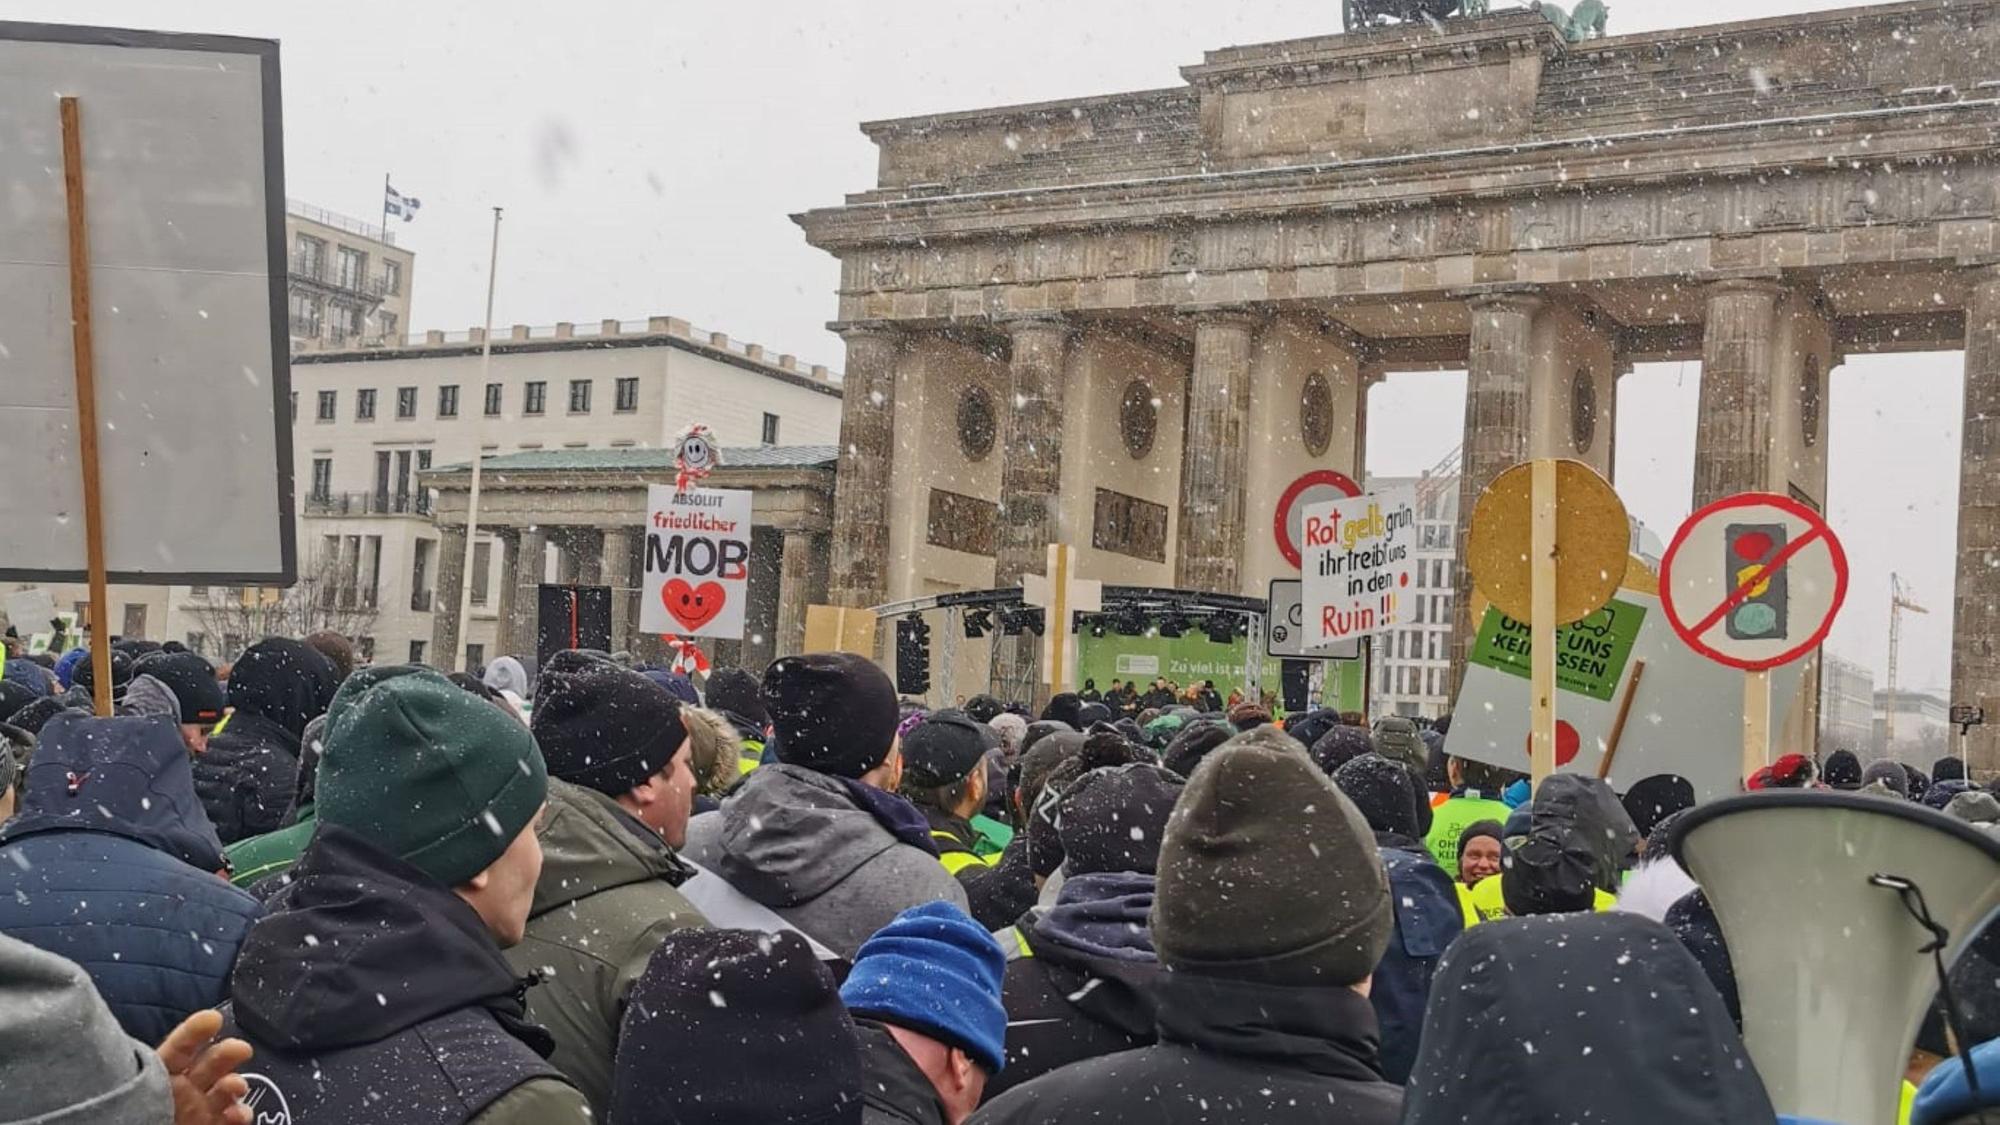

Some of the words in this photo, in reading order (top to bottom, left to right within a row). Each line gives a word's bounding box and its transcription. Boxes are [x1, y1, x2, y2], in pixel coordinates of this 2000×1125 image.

[671, 493, 724, 508] ABSOLUT
[653, 511, 737, 532] friedlicher
[645, 533, 749, 580] MOB
[1319, 549, 1346, 576] ihr
[1346, 542, 1388, 571] treibt
[1388, 544, 1406, 563] uns
[1348, 575, 1363, 597] in
[1367, 571, 1393, 593] den
[1322, 601, 1374, 638] Ruin
[1567, 633, 1613, 659] UNS
[1555, 652, 1607, 678] SSEN
